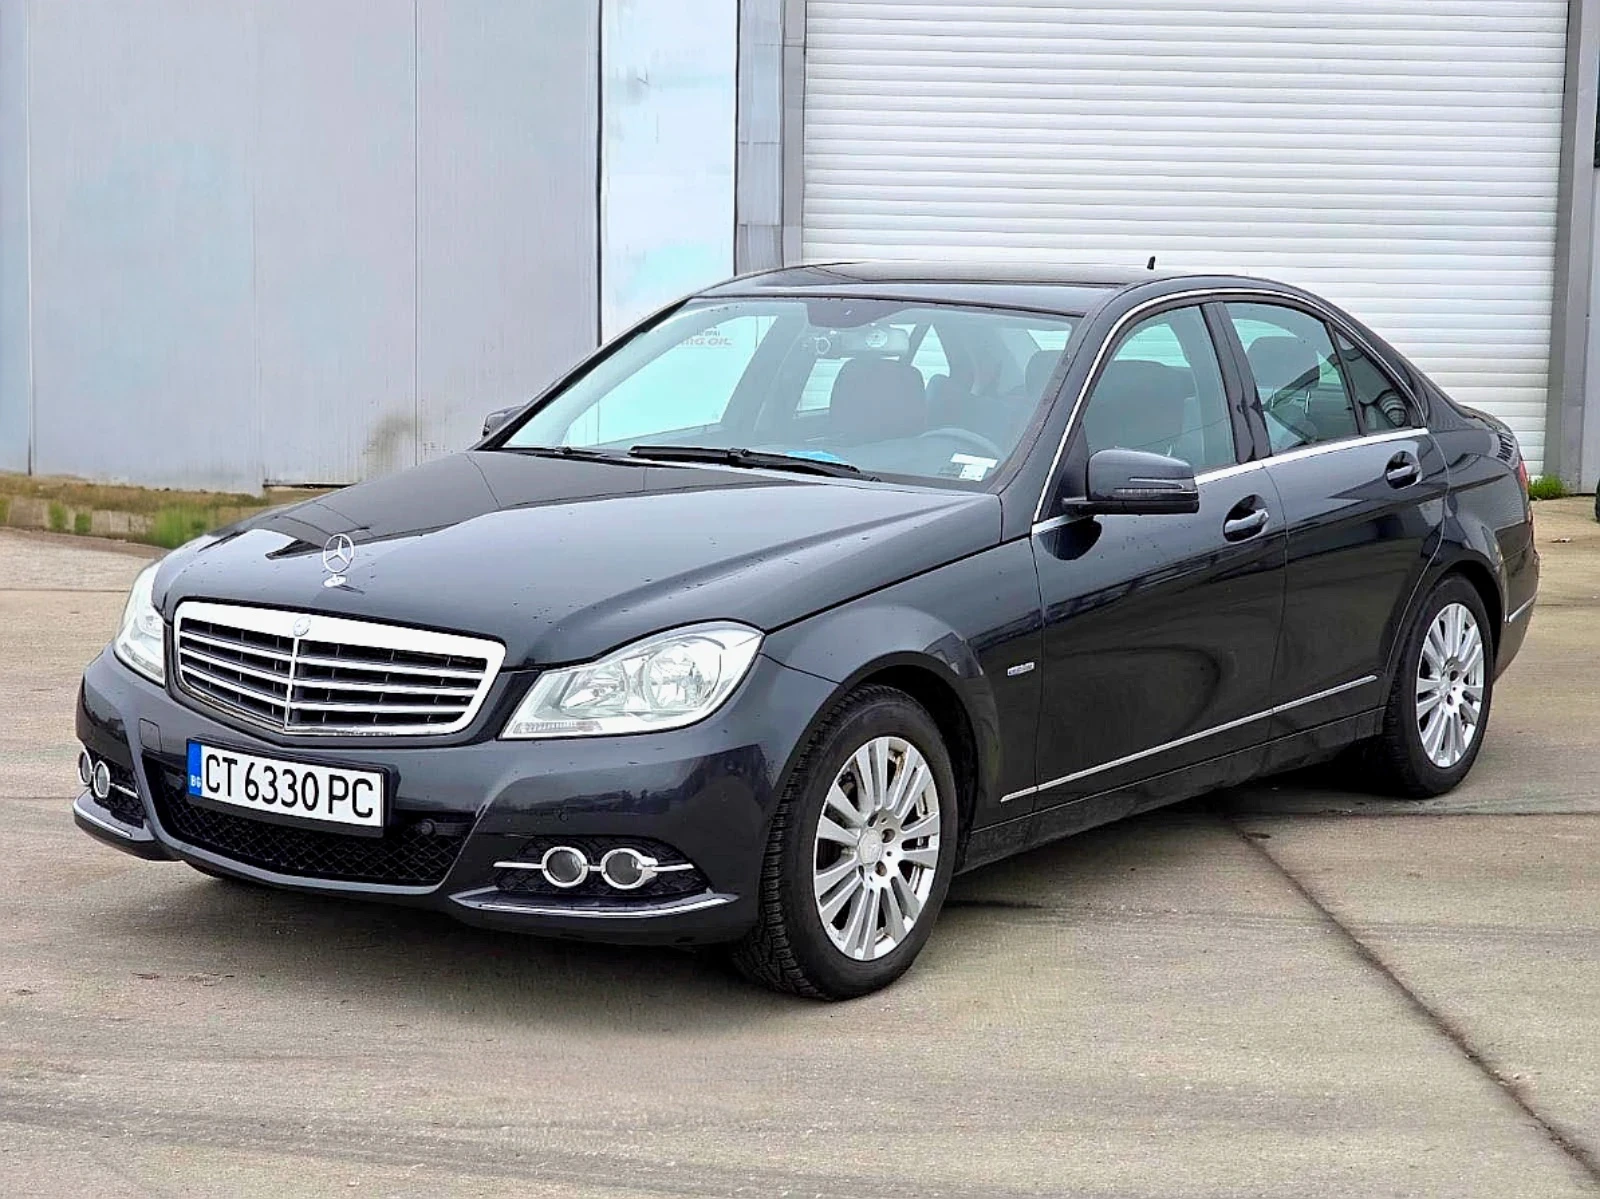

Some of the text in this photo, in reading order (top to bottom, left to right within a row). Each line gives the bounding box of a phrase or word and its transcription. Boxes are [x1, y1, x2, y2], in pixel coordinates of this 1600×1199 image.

[190, 774, 202, 788] BG
[206, 754, 373, 818] CT 6330 PC
